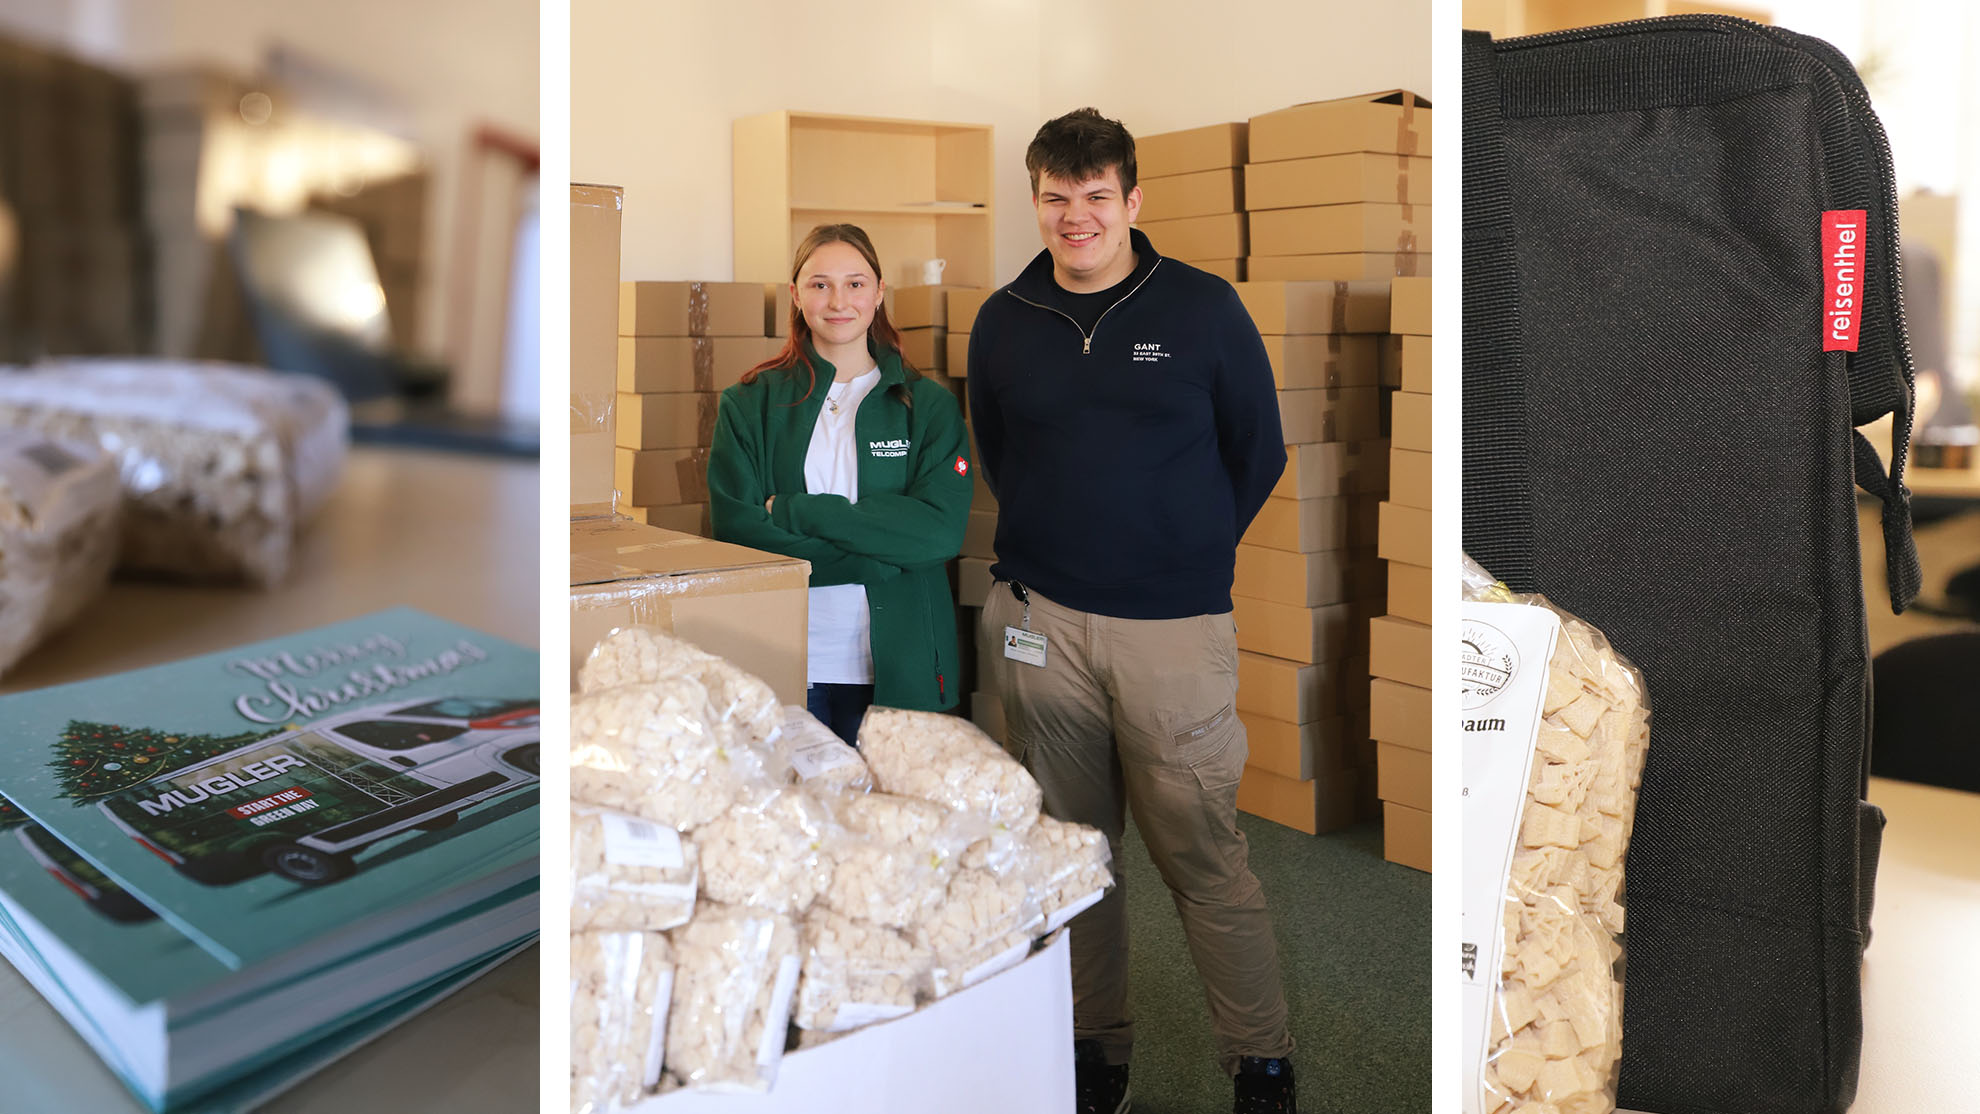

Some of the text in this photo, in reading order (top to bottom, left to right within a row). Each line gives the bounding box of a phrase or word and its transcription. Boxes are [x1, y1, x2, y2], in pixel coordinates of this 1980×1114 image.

[1829, 224, 1856, 340] reisenthel
[231, 634, 406, 681] Merry
[235, 640, 487, 724] Christmas
[1462, 719, 1506, 731] aum
[137, 754, 306, 816] MUGLER
[237, 789, 304, 816] START THE
[249, 798, 320, 827] GREEN WAY
